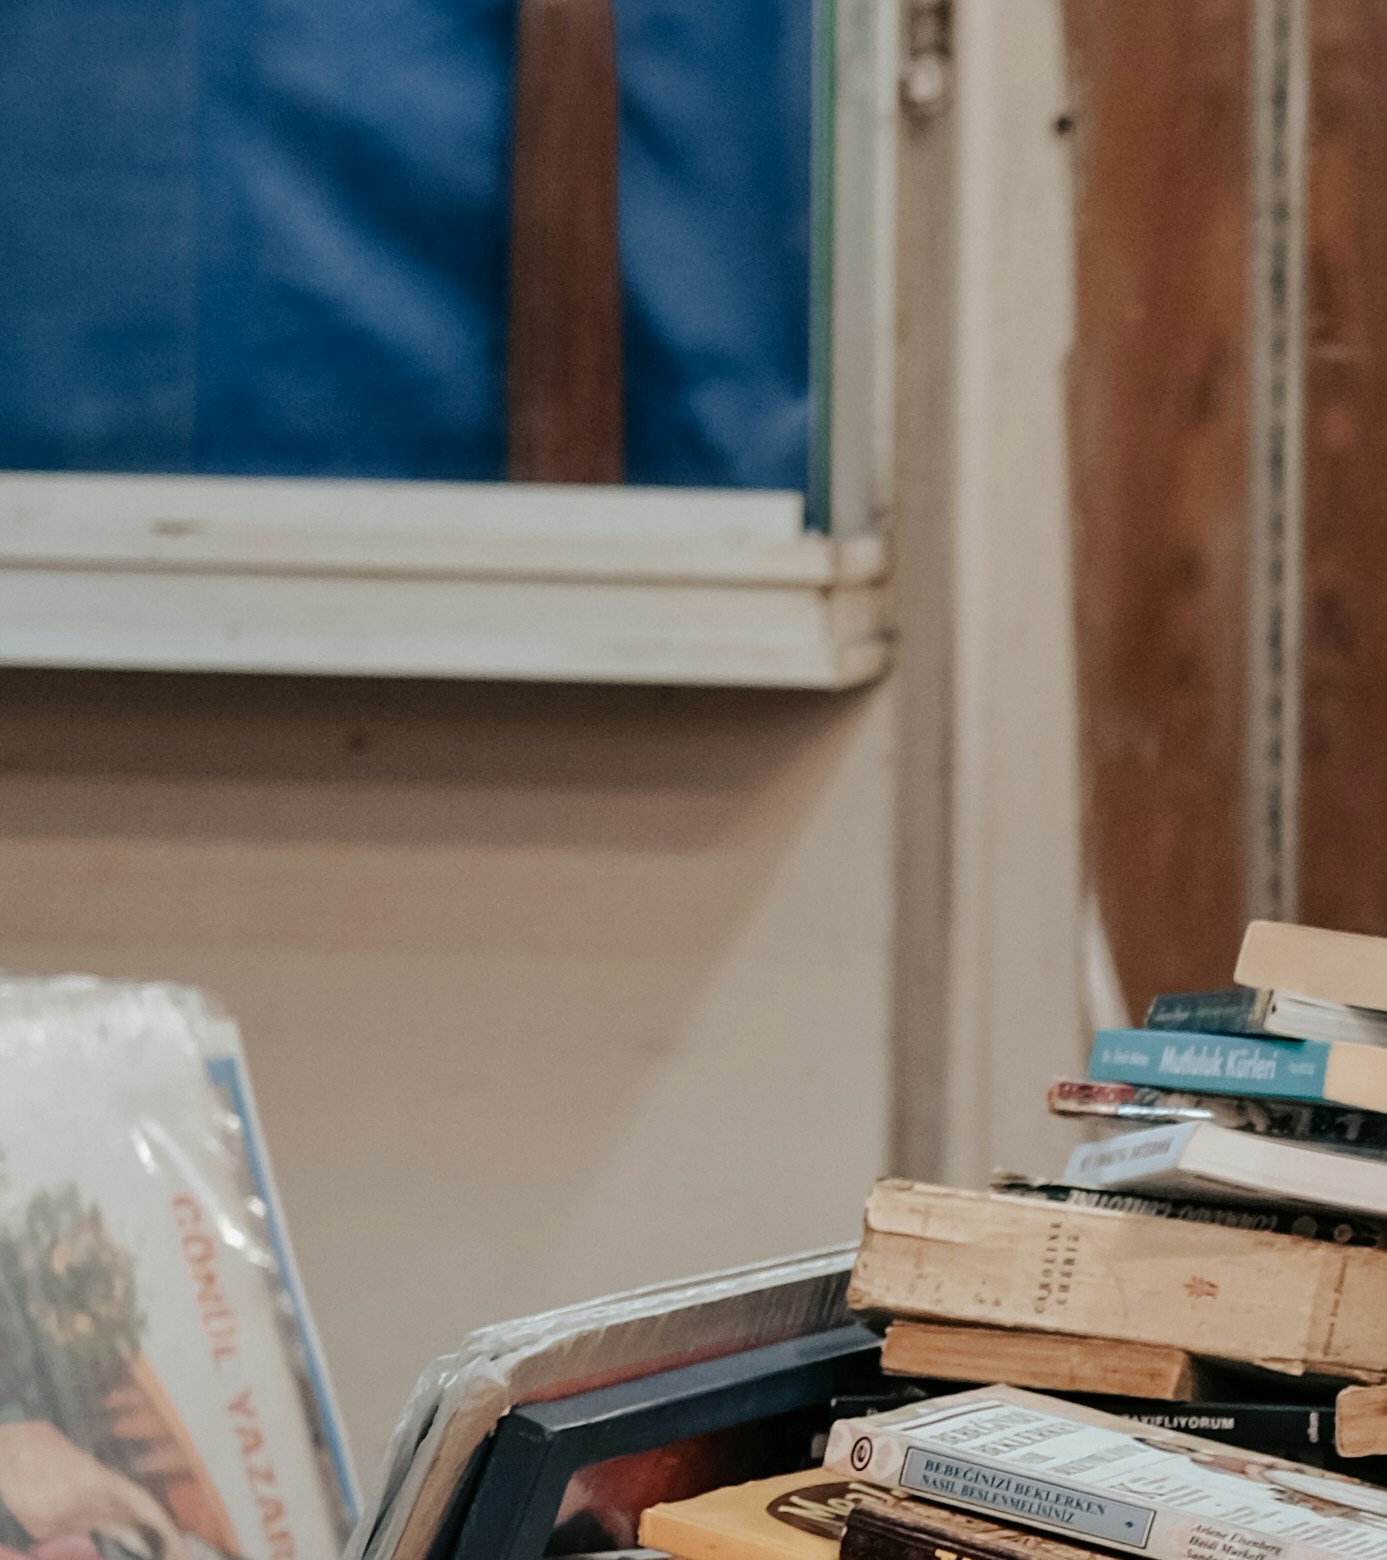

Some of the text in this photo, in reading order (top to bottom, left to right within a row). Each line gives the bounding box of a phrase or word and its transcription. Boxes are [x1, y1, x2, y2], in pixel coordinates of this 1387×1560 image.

[1158, 1046, 1222, 1078] Mutluluk
[1225, 1048, 1278, 1080] Kürleri
[925, 1459, 1106, 1516] BEBEĞİNİZİ BEKLERKEN
